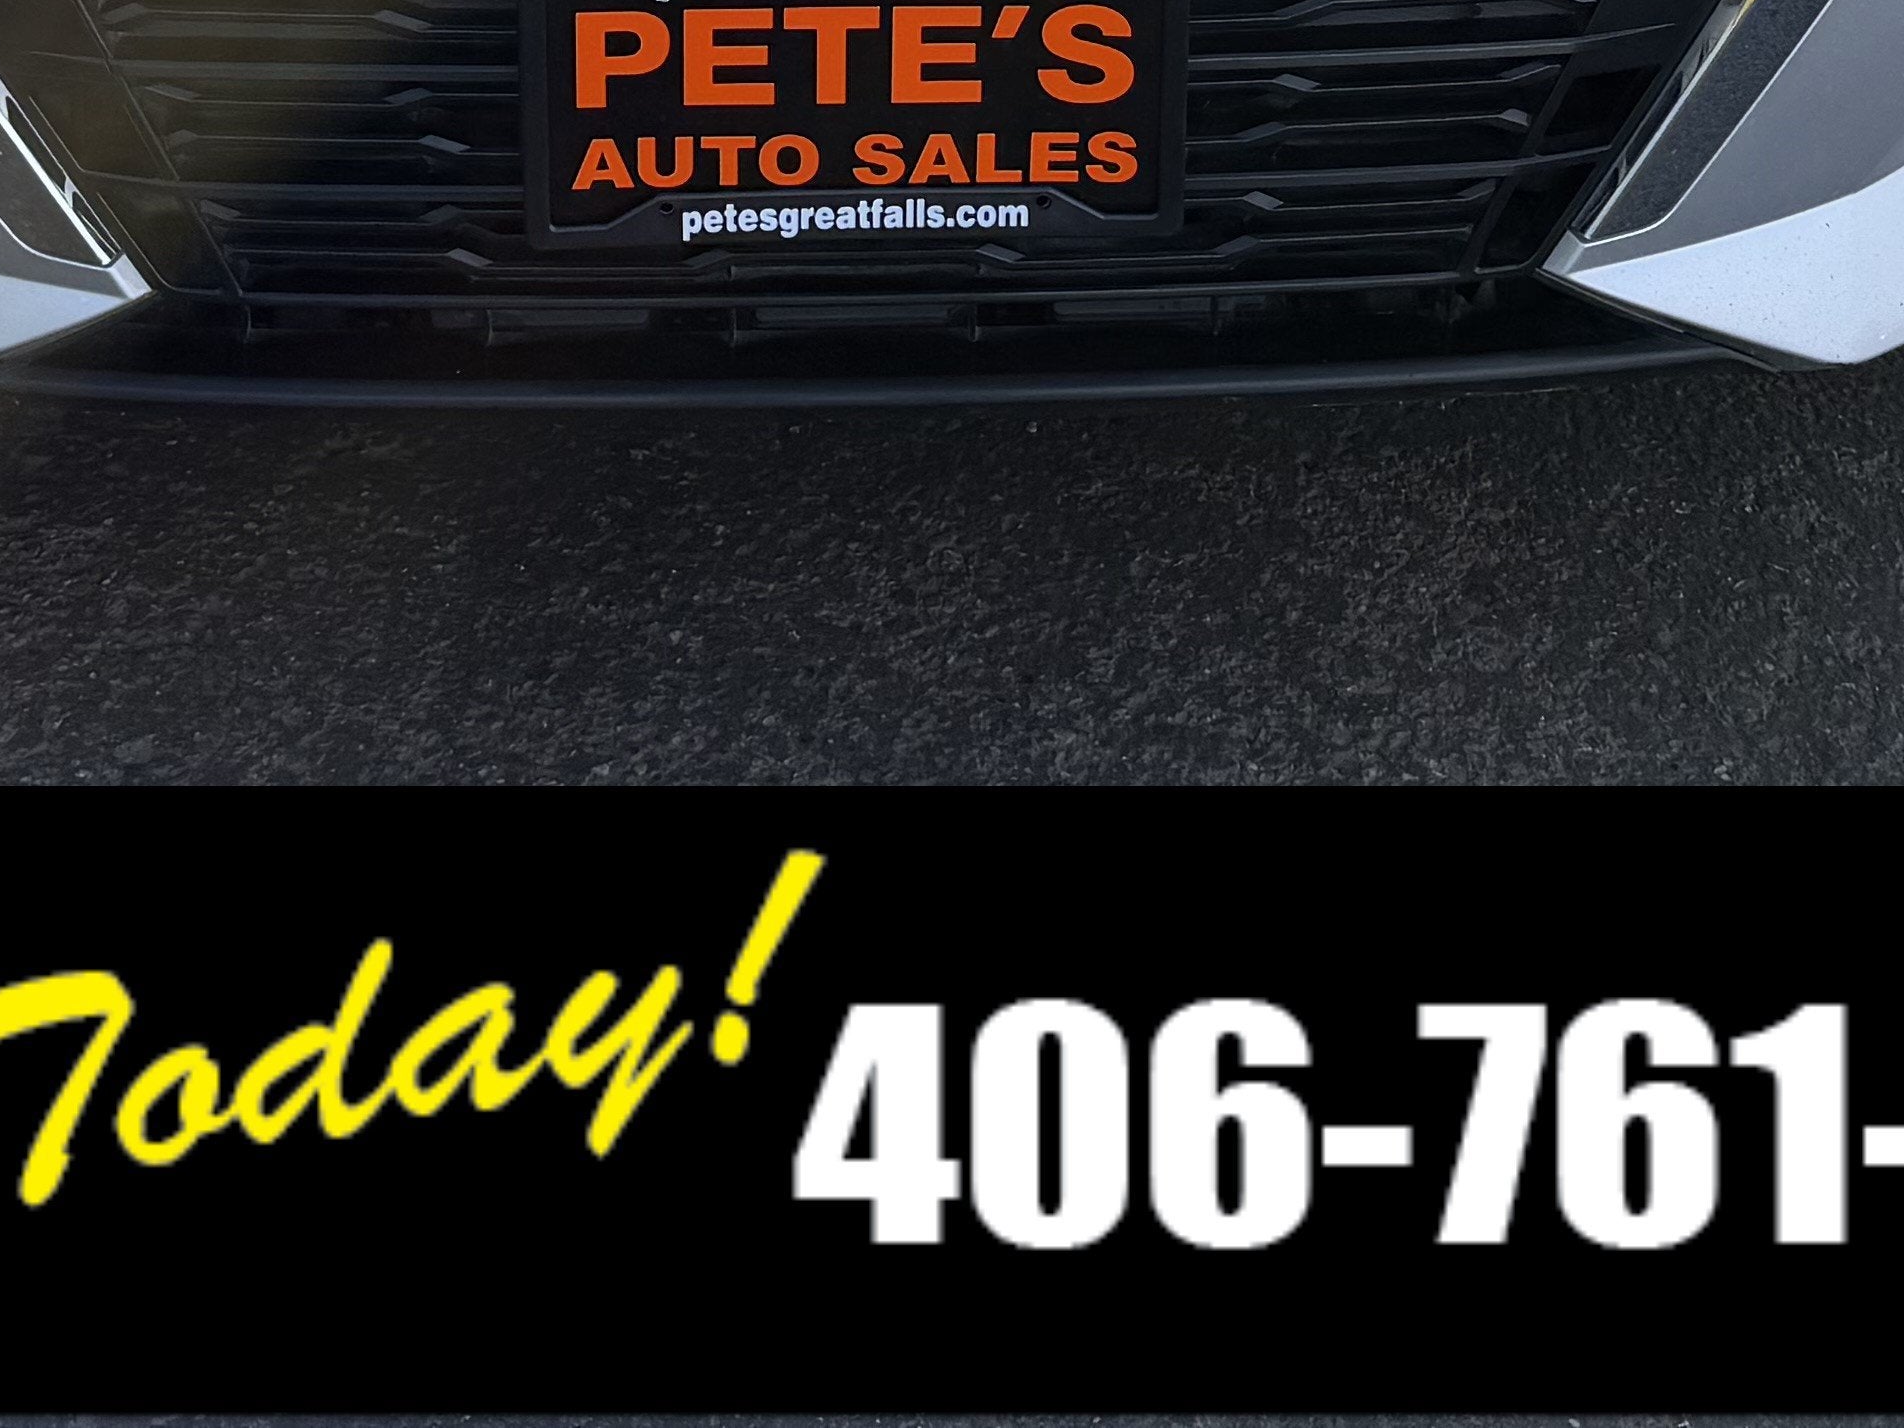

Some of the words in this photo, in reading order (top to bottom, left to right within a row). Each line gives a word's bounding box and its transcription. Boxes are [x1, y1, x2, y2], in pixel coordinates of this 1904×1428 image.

[575, 4, 1136, 110] PETE'S
[572, 135, 821, 191] AUTO
[852, 132, 1139, 186] SALES
[681, 197, 1030, 243] petesgreatfalls.com
